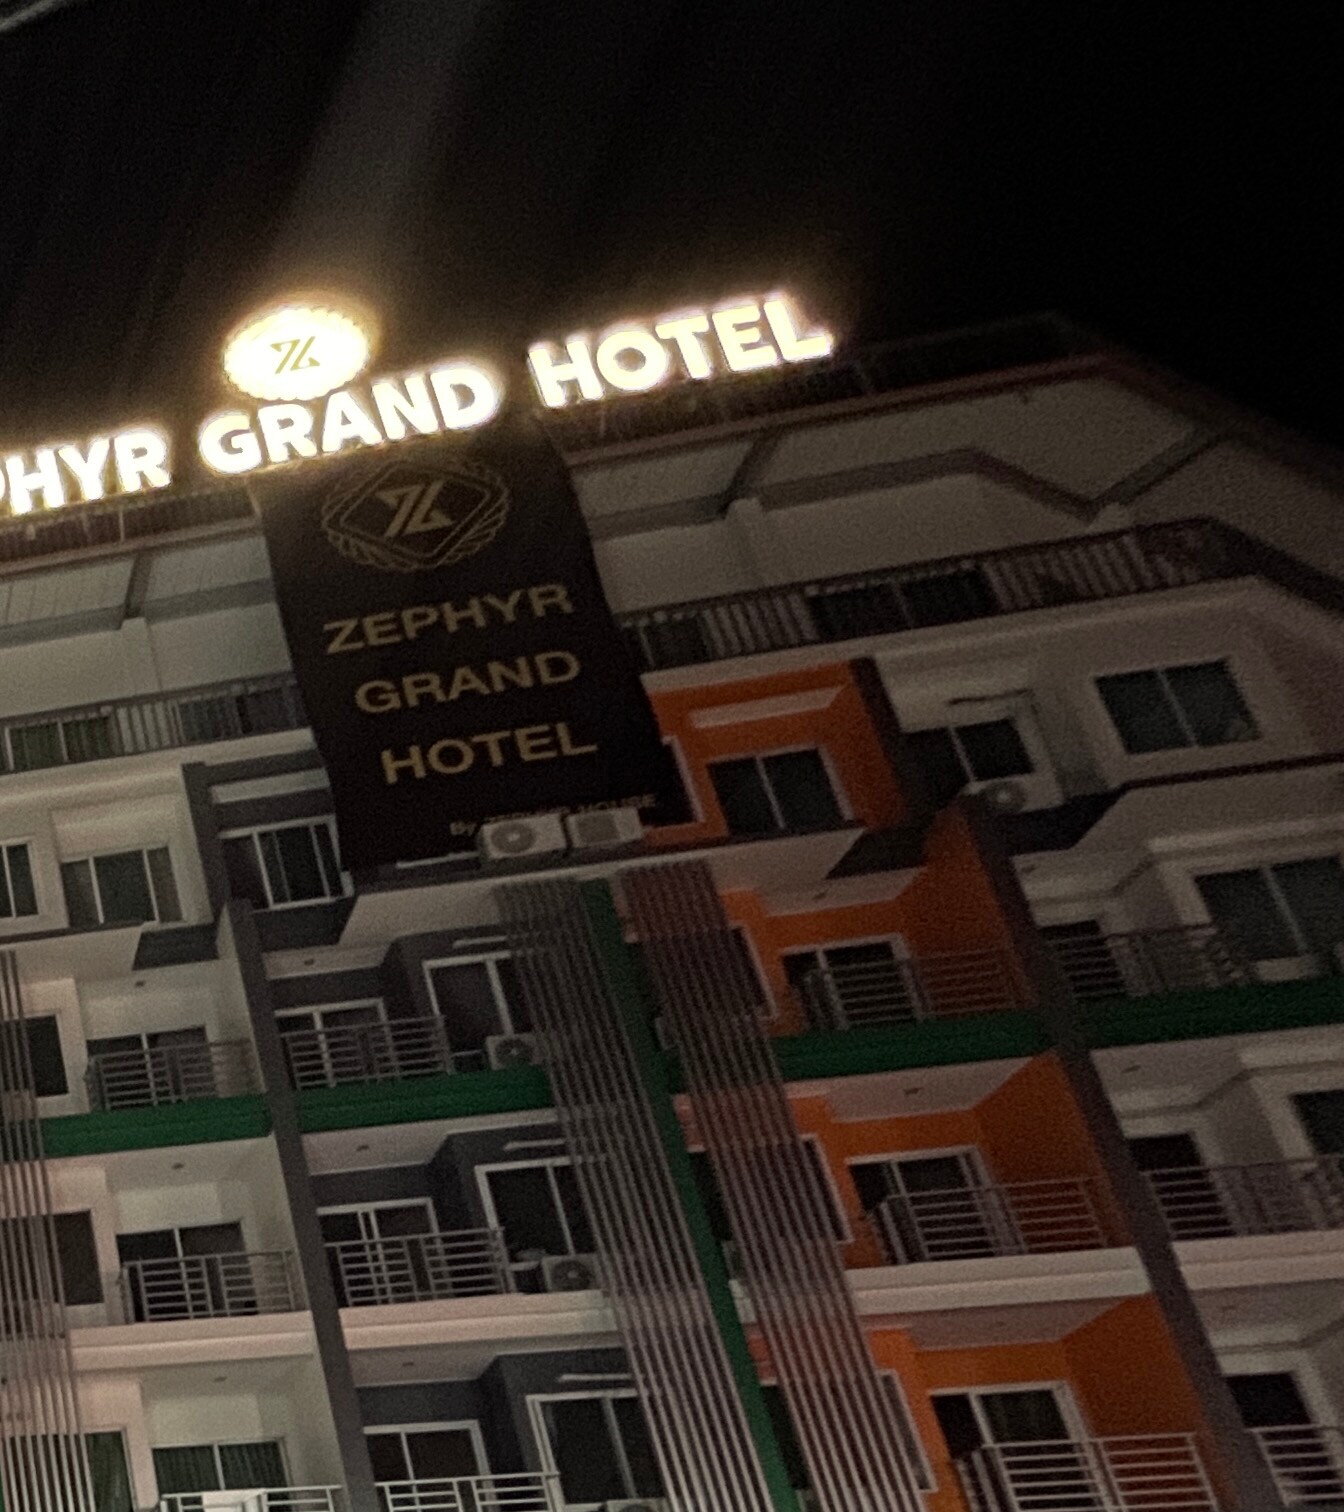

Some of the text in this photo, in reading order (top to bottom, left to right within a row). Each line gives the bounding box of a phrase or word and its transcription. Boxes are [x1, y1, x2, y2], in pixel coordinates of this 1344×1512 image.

[199, 364, 500, 474] GRAND
[526, 293, 834, 408] HOTEL
[323, 584, 574, 654] ZEPHYR
[355, 651, 582, 713] GRAND
[380, 722, 598, 785] HOTEL
